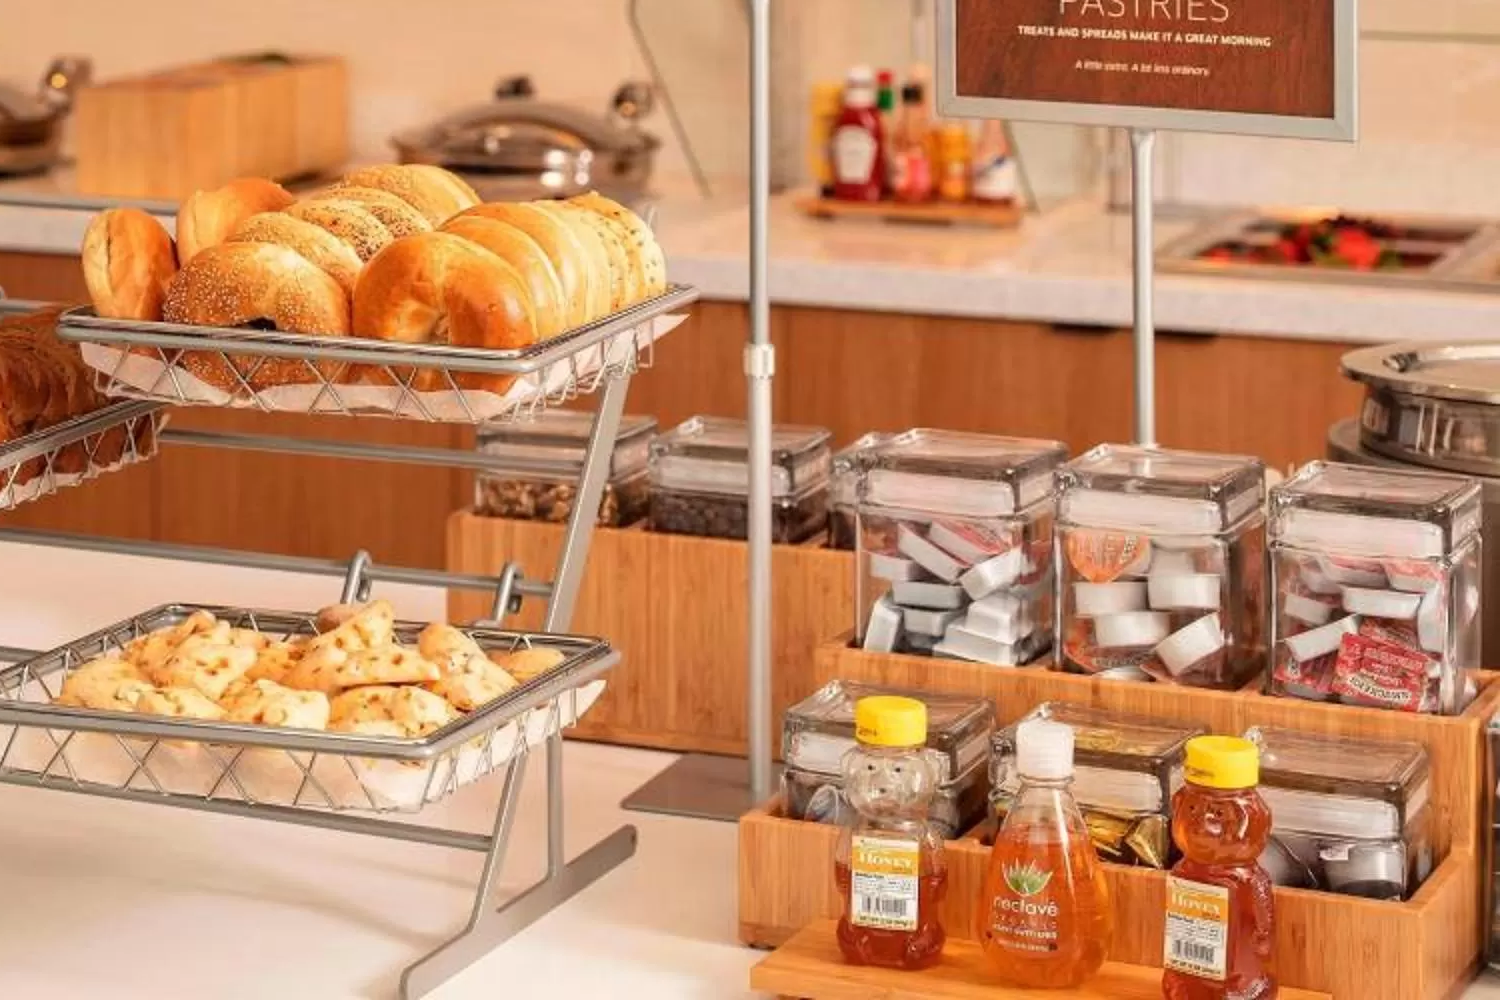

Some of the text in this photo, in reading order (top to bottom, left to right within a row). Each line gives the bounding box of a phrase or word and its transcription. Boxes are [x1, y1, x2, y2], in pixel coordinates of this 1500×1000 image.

[1017, 25, 1272, 47] TREATS AND SPREADS MAKE IT A GREAT MORNING
